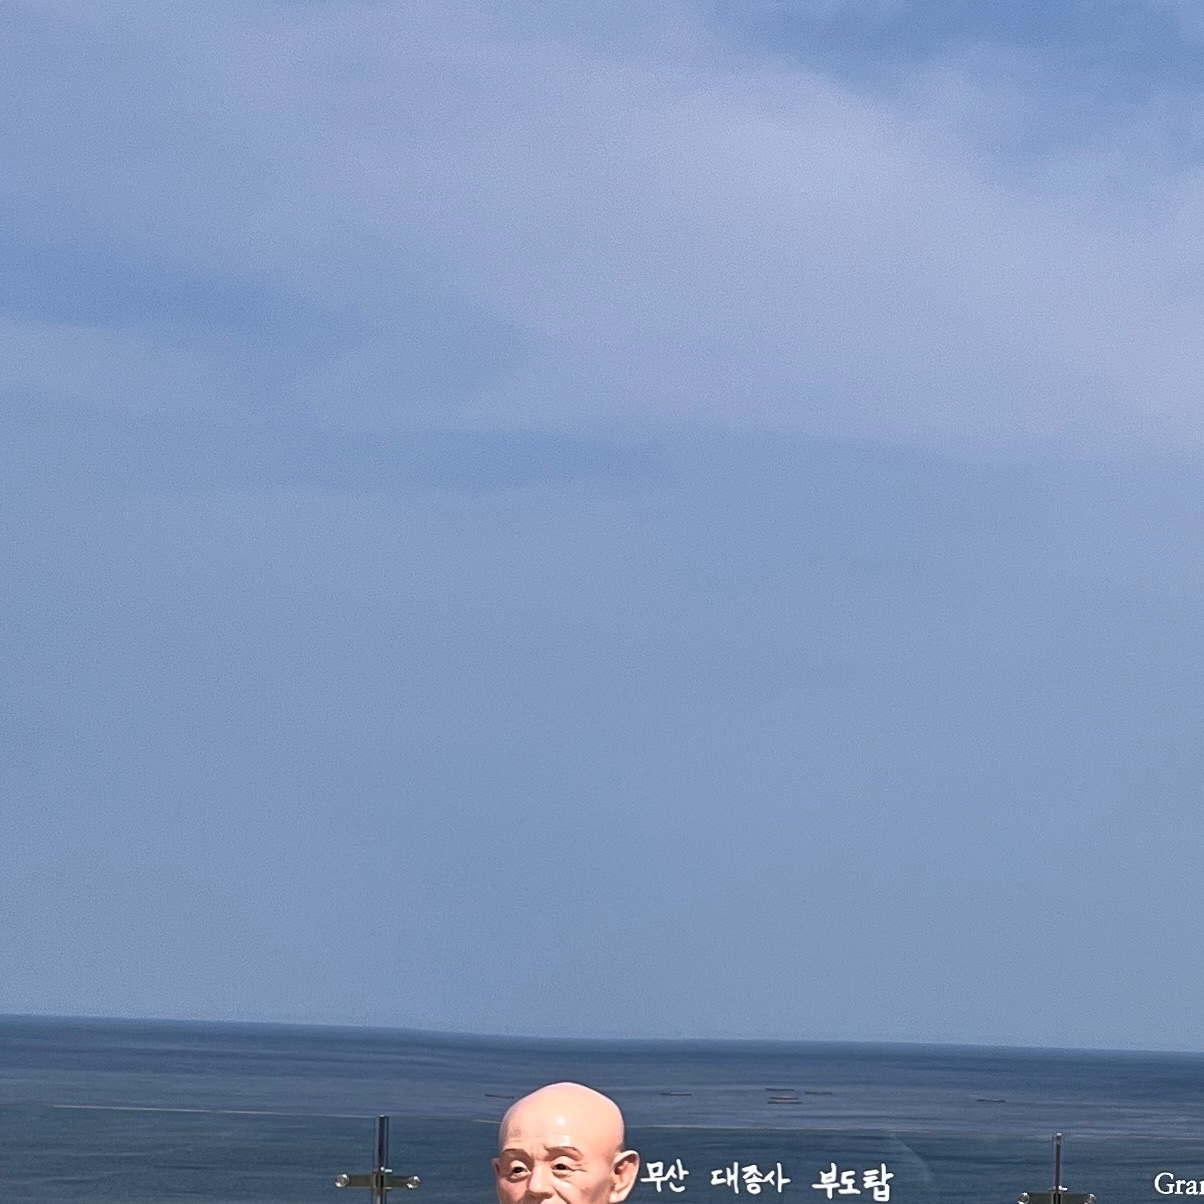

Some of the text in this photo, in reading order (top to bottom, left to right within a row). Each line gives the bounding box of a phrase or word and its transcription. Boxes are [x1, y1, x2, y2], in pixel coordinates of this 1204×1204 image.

[641, 1159, 894, 1202] 무산 대종사 부도탑
